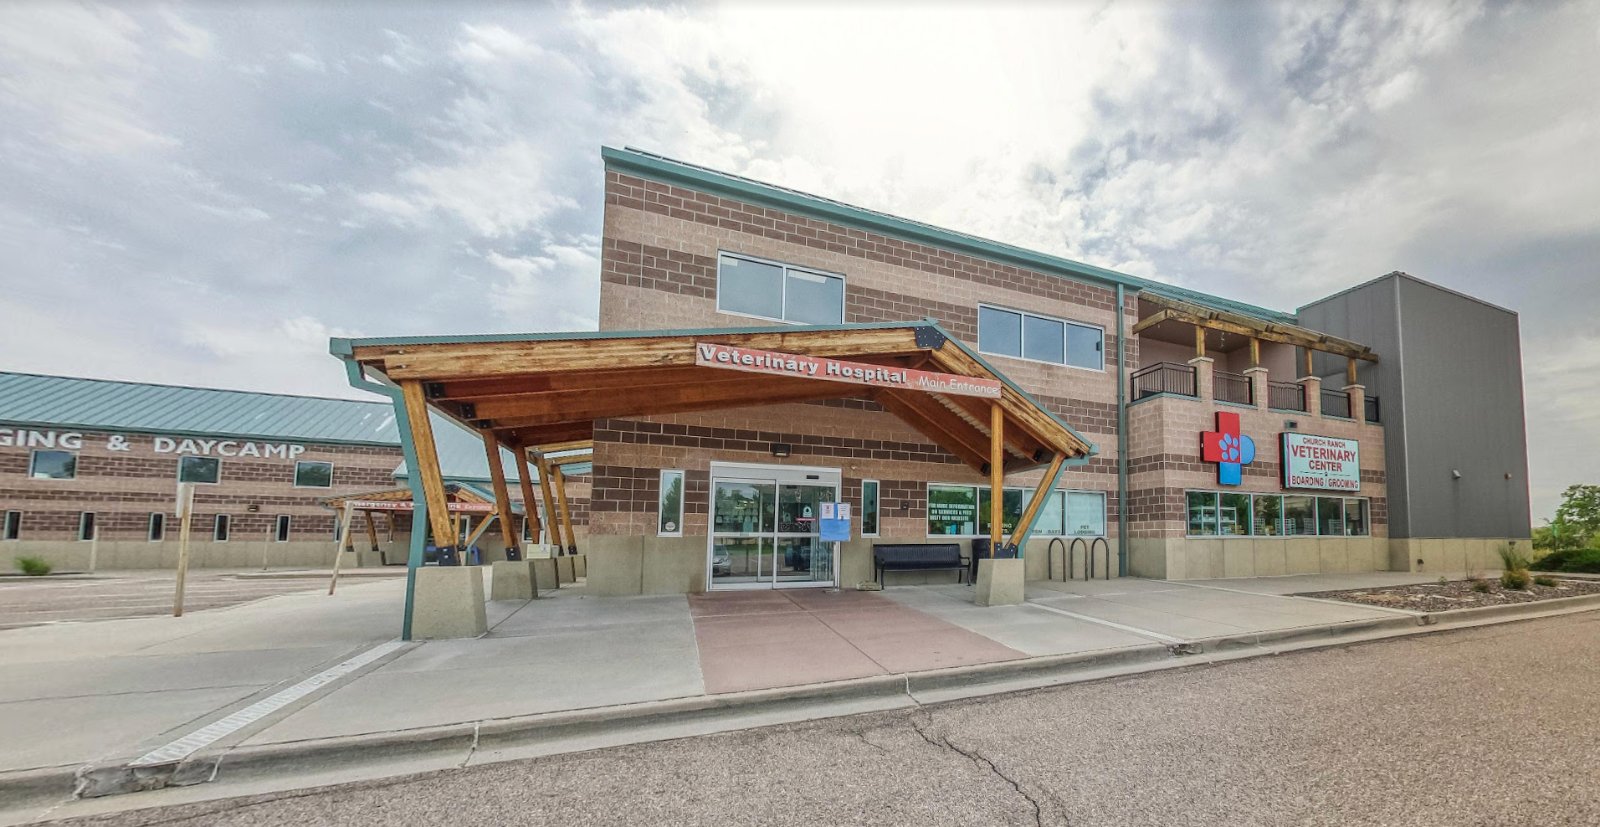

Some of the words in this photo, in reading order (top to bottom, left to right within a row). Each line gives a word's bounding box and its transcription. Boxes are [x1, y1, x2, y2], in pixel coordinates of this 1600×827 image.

[700, 345, 819, 376] Veterinary
[826, 361, 908, 385] Hospital
[919, 375, 946, 389] Main
[949, 378, 1000, 395] Entrance
[106, 434, 131, 451] &
[154, 436, 306, 460] DAYCAMP
[1302, 437, 1326, 447] CHURCH
[1327, 439, 1346, 449] RANCH
[1291, 444, 1356, 463] VETERINARY
[1308, 460, 1343, 472] CENTER
[1291, 475, 1324, 487] BOARDING
[1328, 478, 1359, 489] GROOMING
